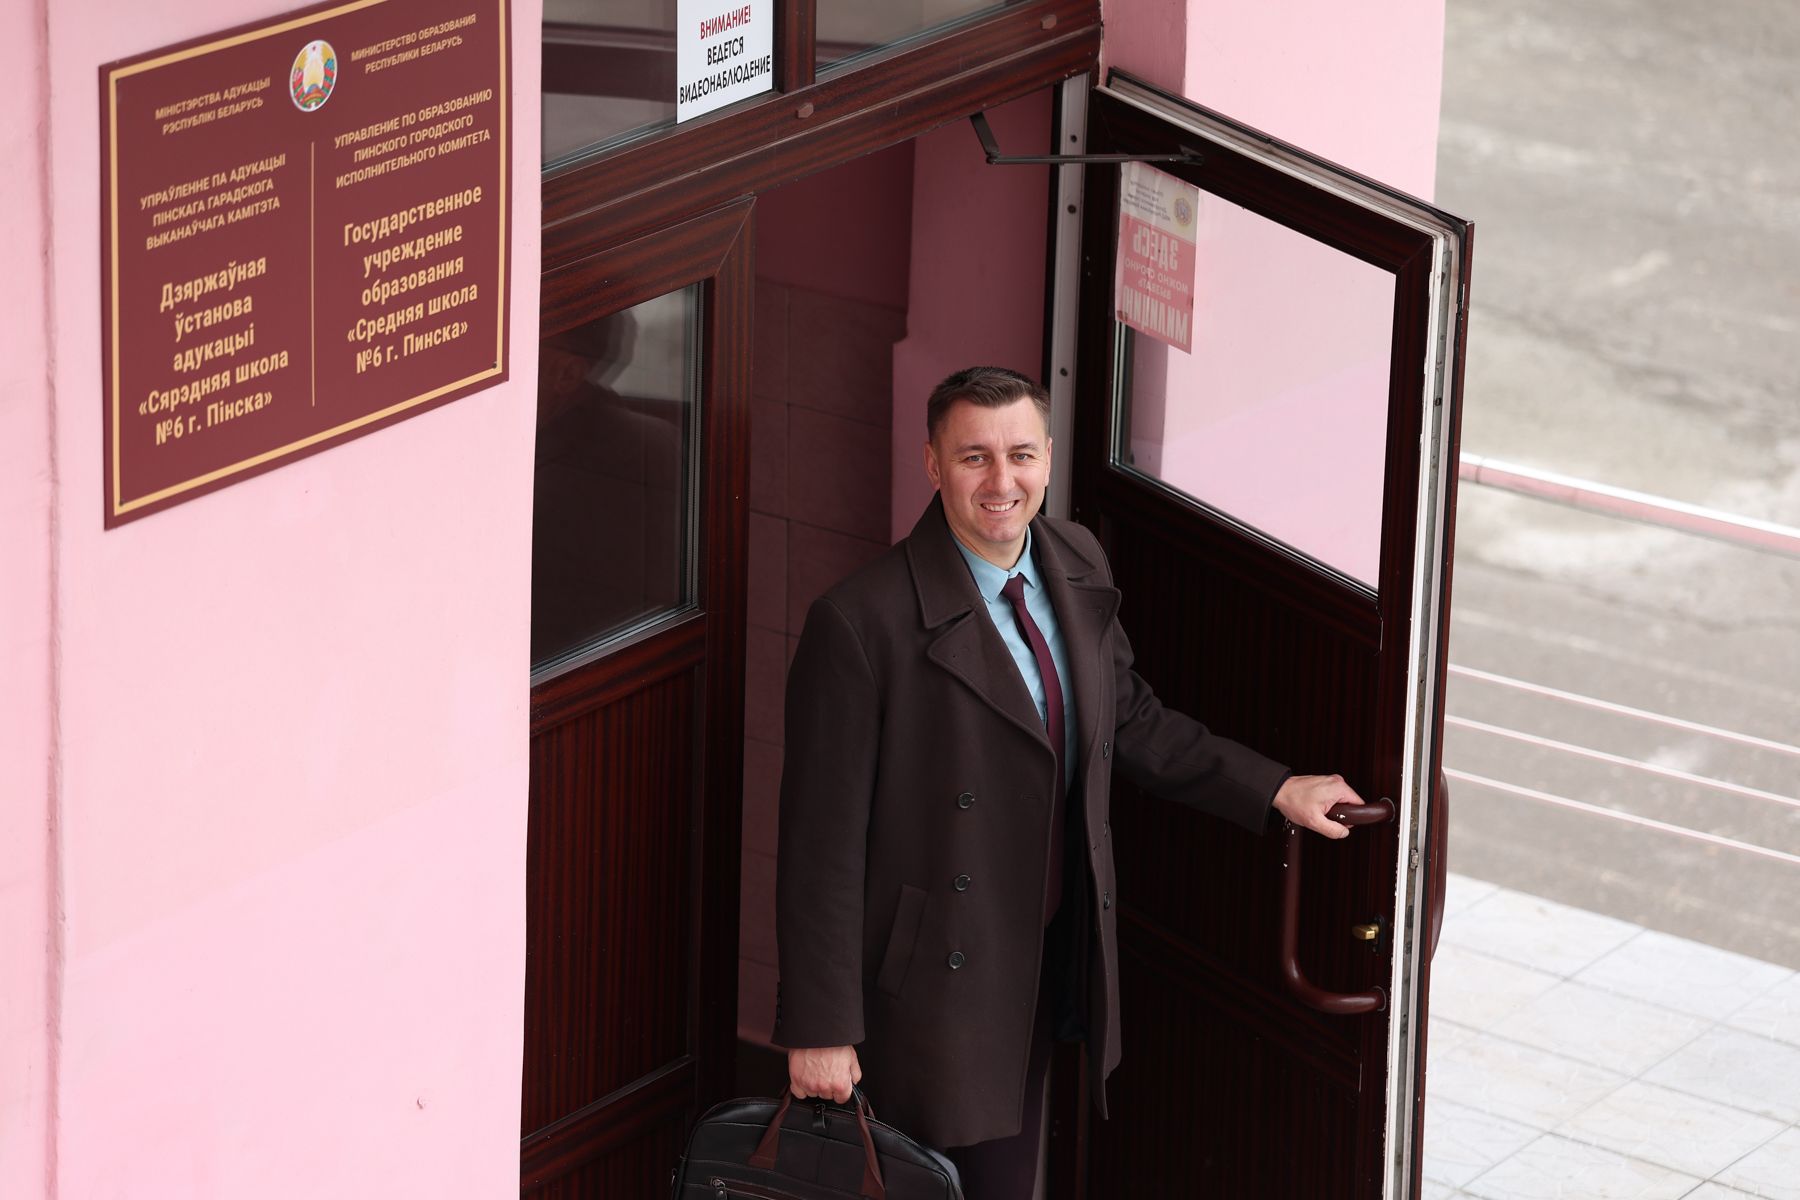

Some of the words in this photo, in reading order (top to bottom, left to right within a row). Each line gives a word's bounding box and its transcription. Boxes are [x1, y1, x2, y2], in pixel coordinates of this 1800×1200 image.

[351, 32, 417, 61] МИНИСТЕРСТВО
[418, 13, 476, 39] ОБРАЗОВАНИЯ
[700, 5, 751, 40] ВНИМАНИЕ!
[365, 48, 419, 74] РЕСПУБЛИКИ
[421, 35, 463, 57] БЕЛАРУСЬ
[707, 36, 744, 66] ВЕДЕТСЯ
[155, 91, 221, 120] МІНІСТЭРСТВА
[223, 77, 270, 100] АДУКАЦЫІ
[680, 54, 771, 105] ВИДЕОНАБЛЮДЕНИЕ
[162, 111, 216, 135] РЭСПУБЛІКІ
[218, 97, 264, 119] БЕЛАРУСЬ
[334, 117, 400, 149] УПРАВЛЕНИЕ
[402, 112, 416, 127] ПО
[418, 88, 492, 122] ОБРАЗОВАНИЮ
[354, 135, 407, 163] ПИНСКОГО
[409, 114, 473, 145] ГОРОДСКОГО
[140, 176, 210, 211] УПРАЎЛЕННЕ
[212, 171, 227, 187] ПА
[230, 153, 286, 182] АДУКАЦЫІ
[336, 146, 435, 189] ИСПОЛНИТЕЛЬНОГО
[438, 129, 491, 155] КОМИТЕТА
[146, 212, 225, 250] ВЫКАНАЎЧАГА
[227, 196, 280, 226] КАМІТЭТА
[153, 197, 205, 227] ПІНСКАГА
[207, 178, 274, 209] ГАРАДСКОГА
[344, 185, 482, 246] Государственное
[363, 224, 463, 278] учреждение
[160, 256, 267, 313] Дзяржаўная
[361, 256, 464, 306] образования
[174, 295, 253, 343] ўстанова
[347, 303, 424, 343] «Средняя
[428, 283, 478, 315] школа
[173, 323, 254, 373] адукацыі
[356, 345, 382, 374] №6
[386, 345, 399, 363] г.
[403, 320, 468, 357] Пинска»
[138, 370, 231, 416] «Сярэдняя
[235, 350, 289, 384] школа
[155, 416, 184, 446] №6
[188, 415, 202, 434] г.
[207, 391, 273, 427] Пінска»
